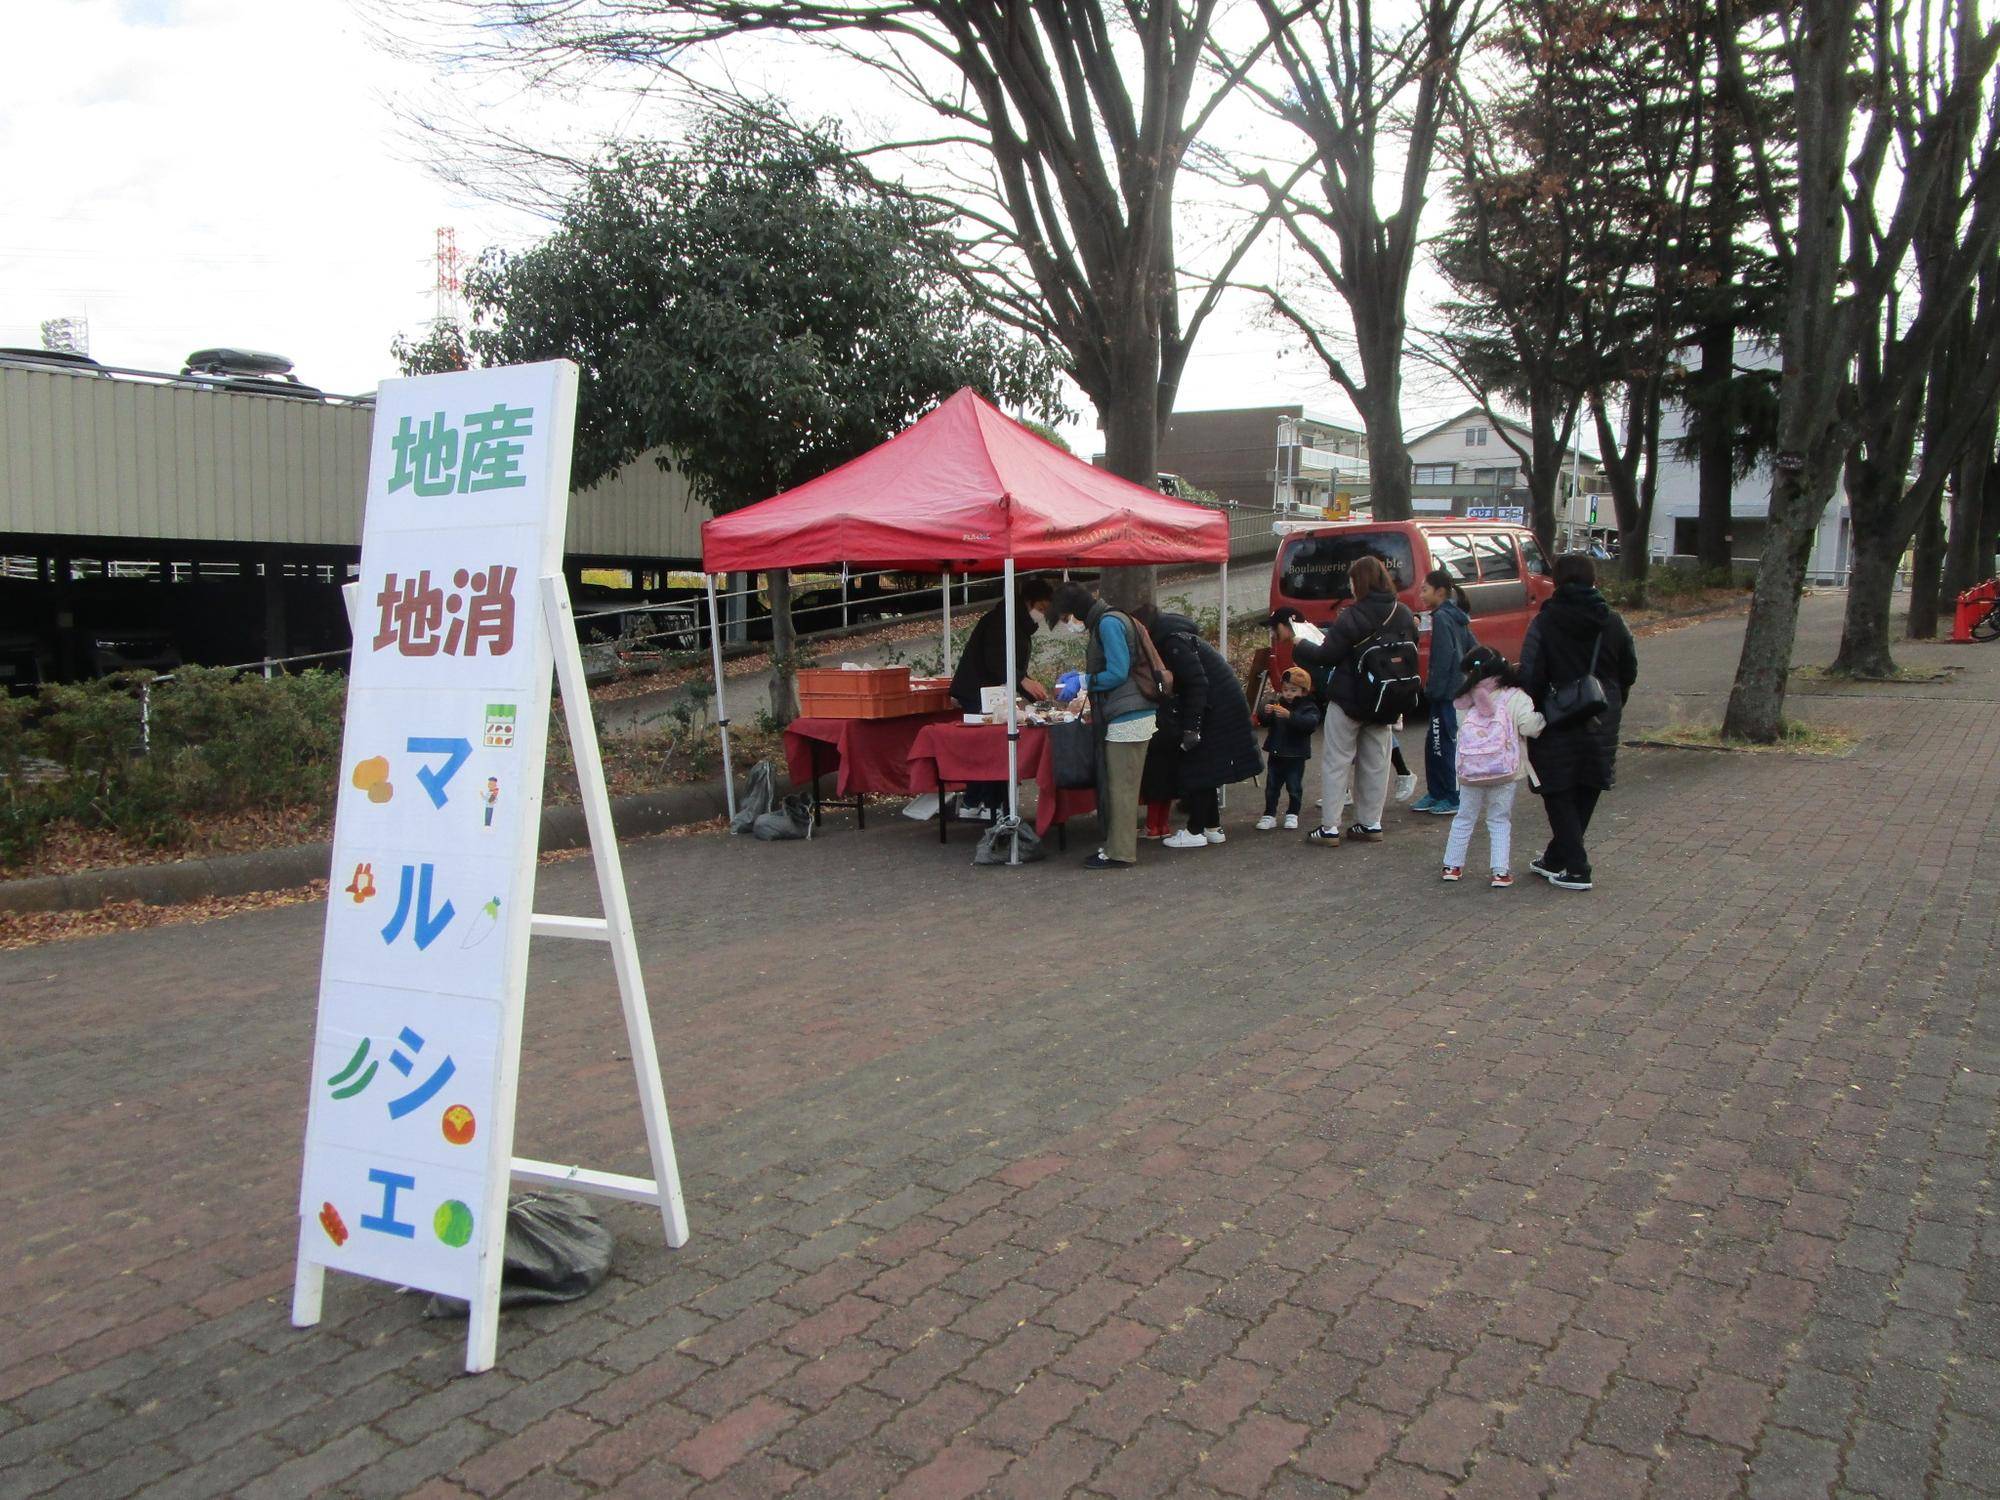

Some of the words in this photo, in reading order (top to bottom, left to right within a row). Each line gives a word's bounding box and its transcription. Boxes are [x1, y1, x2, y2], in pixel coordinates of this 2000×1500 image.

[387, 403, 534, 497] 地産
[372, 564, 518, 657] 地消
[1288, 561, 1347, 575] Boulangerie
